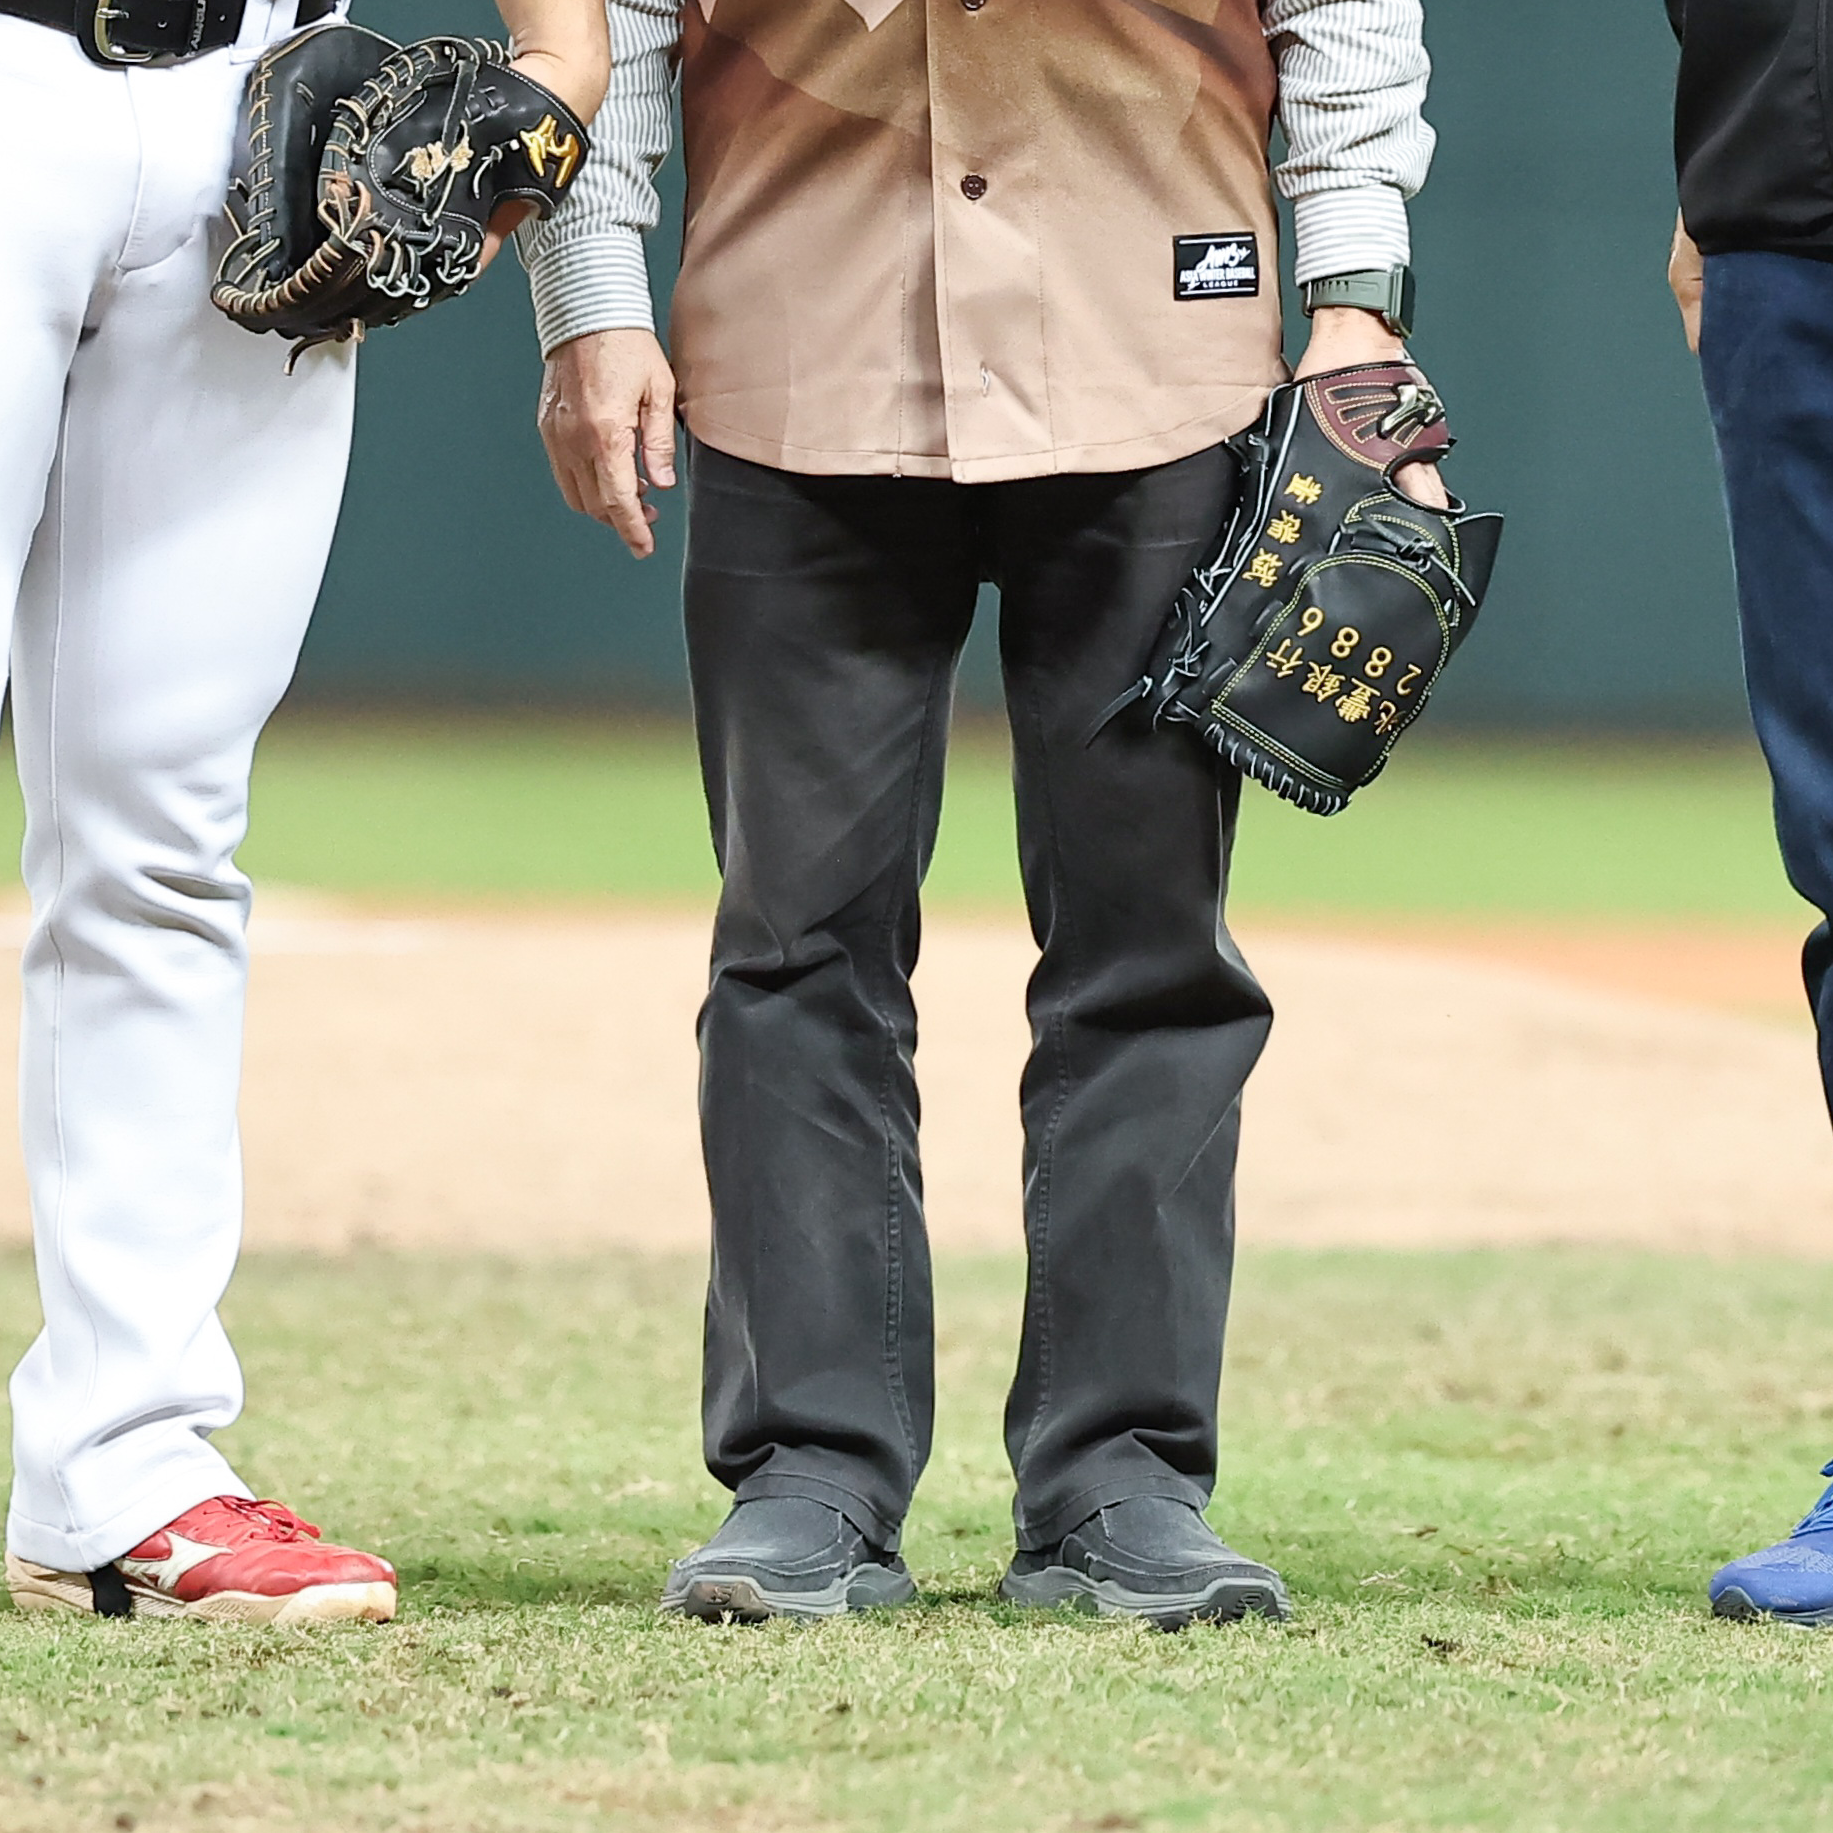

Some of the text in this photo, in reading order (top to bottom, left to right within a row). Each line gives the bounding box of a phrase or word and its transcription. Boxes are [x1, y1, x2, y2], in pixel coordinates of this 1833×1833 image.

[1202, 280, 1238, 288] LEAGUE
[1266, 637, 1407, 736] 兆豐銀行
[1297, 606, 1423, 696] 2886
